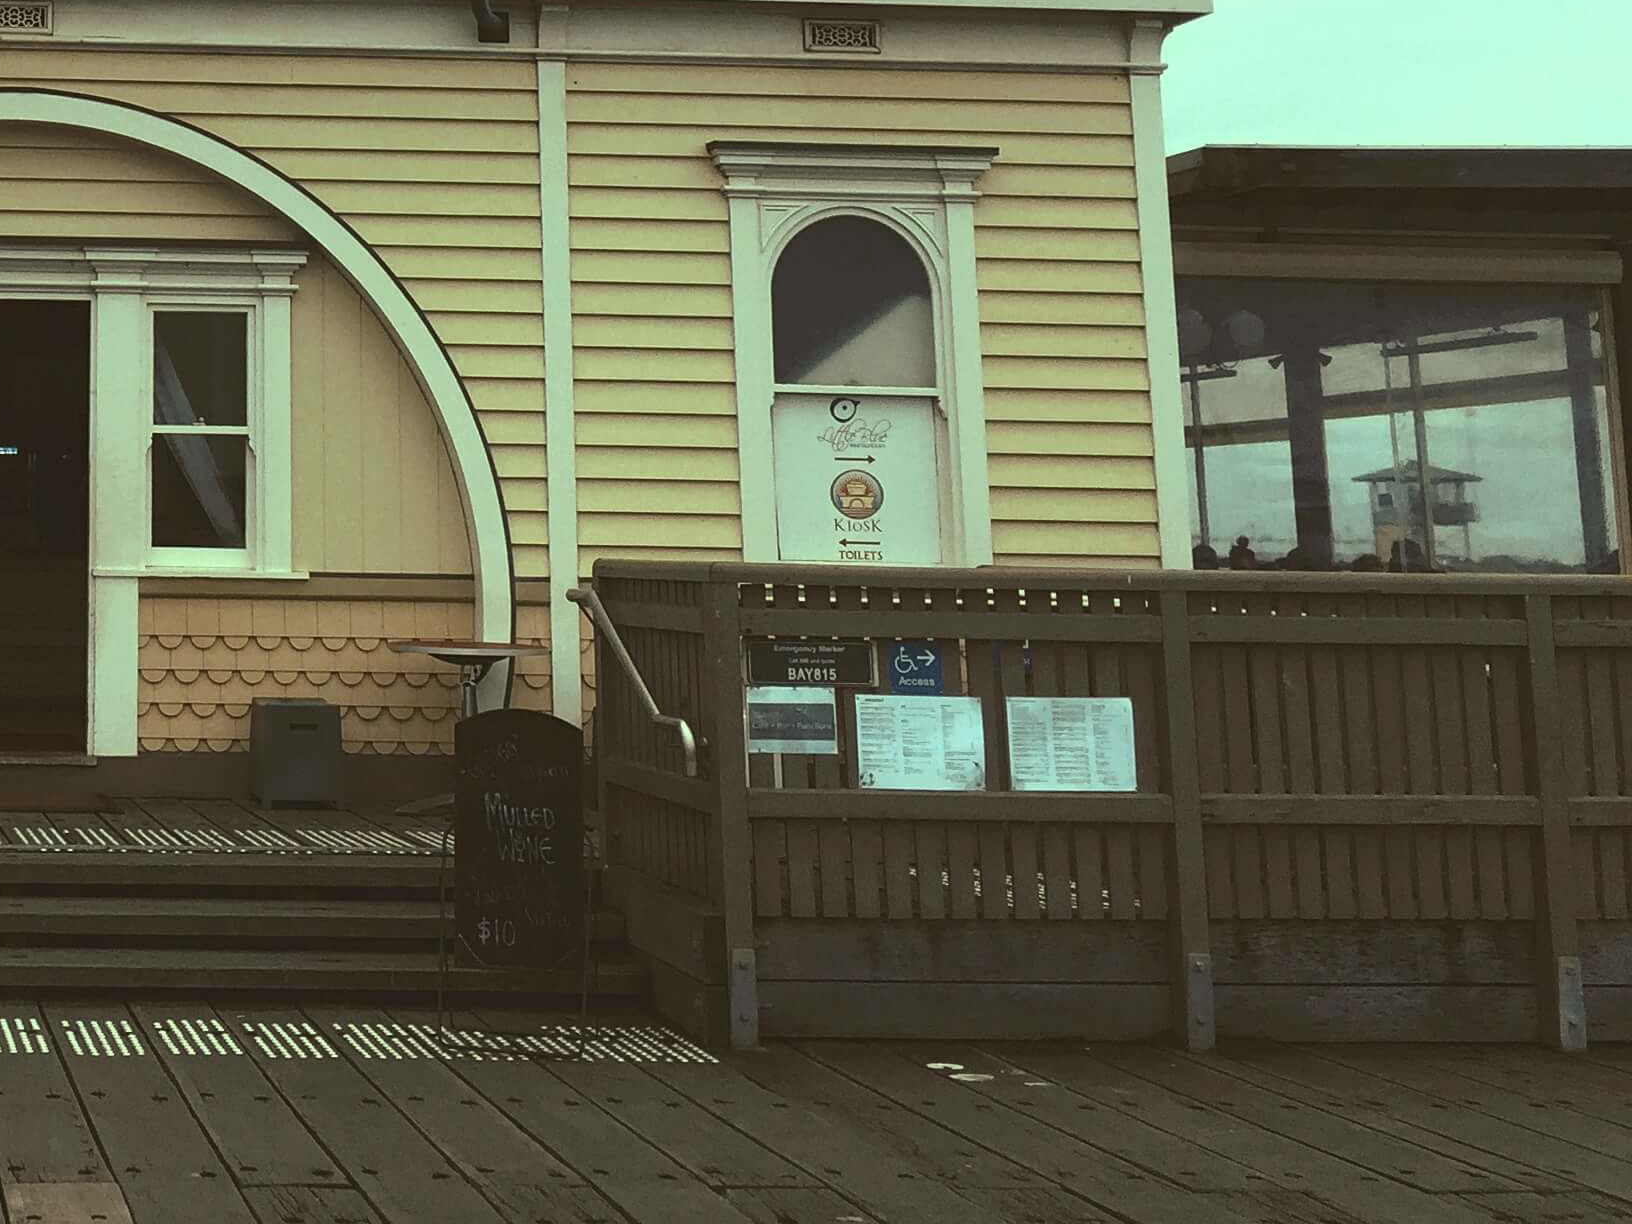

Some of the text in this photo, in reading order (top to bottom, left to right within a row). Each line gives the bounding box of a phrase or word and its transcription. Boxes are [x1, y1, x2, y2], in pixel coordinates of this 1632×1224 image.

[839, 550, 883, 561] TOILETS
[773, 644, 846, 654] Emergency Marker
[788, 667, 837, 681] BAY815
[898, 677, 935, 686] Access
[483, 791, 557, 831] MULLED
[496, 829, 556, 865] WINE
[477, 916, 516, 946] $10
